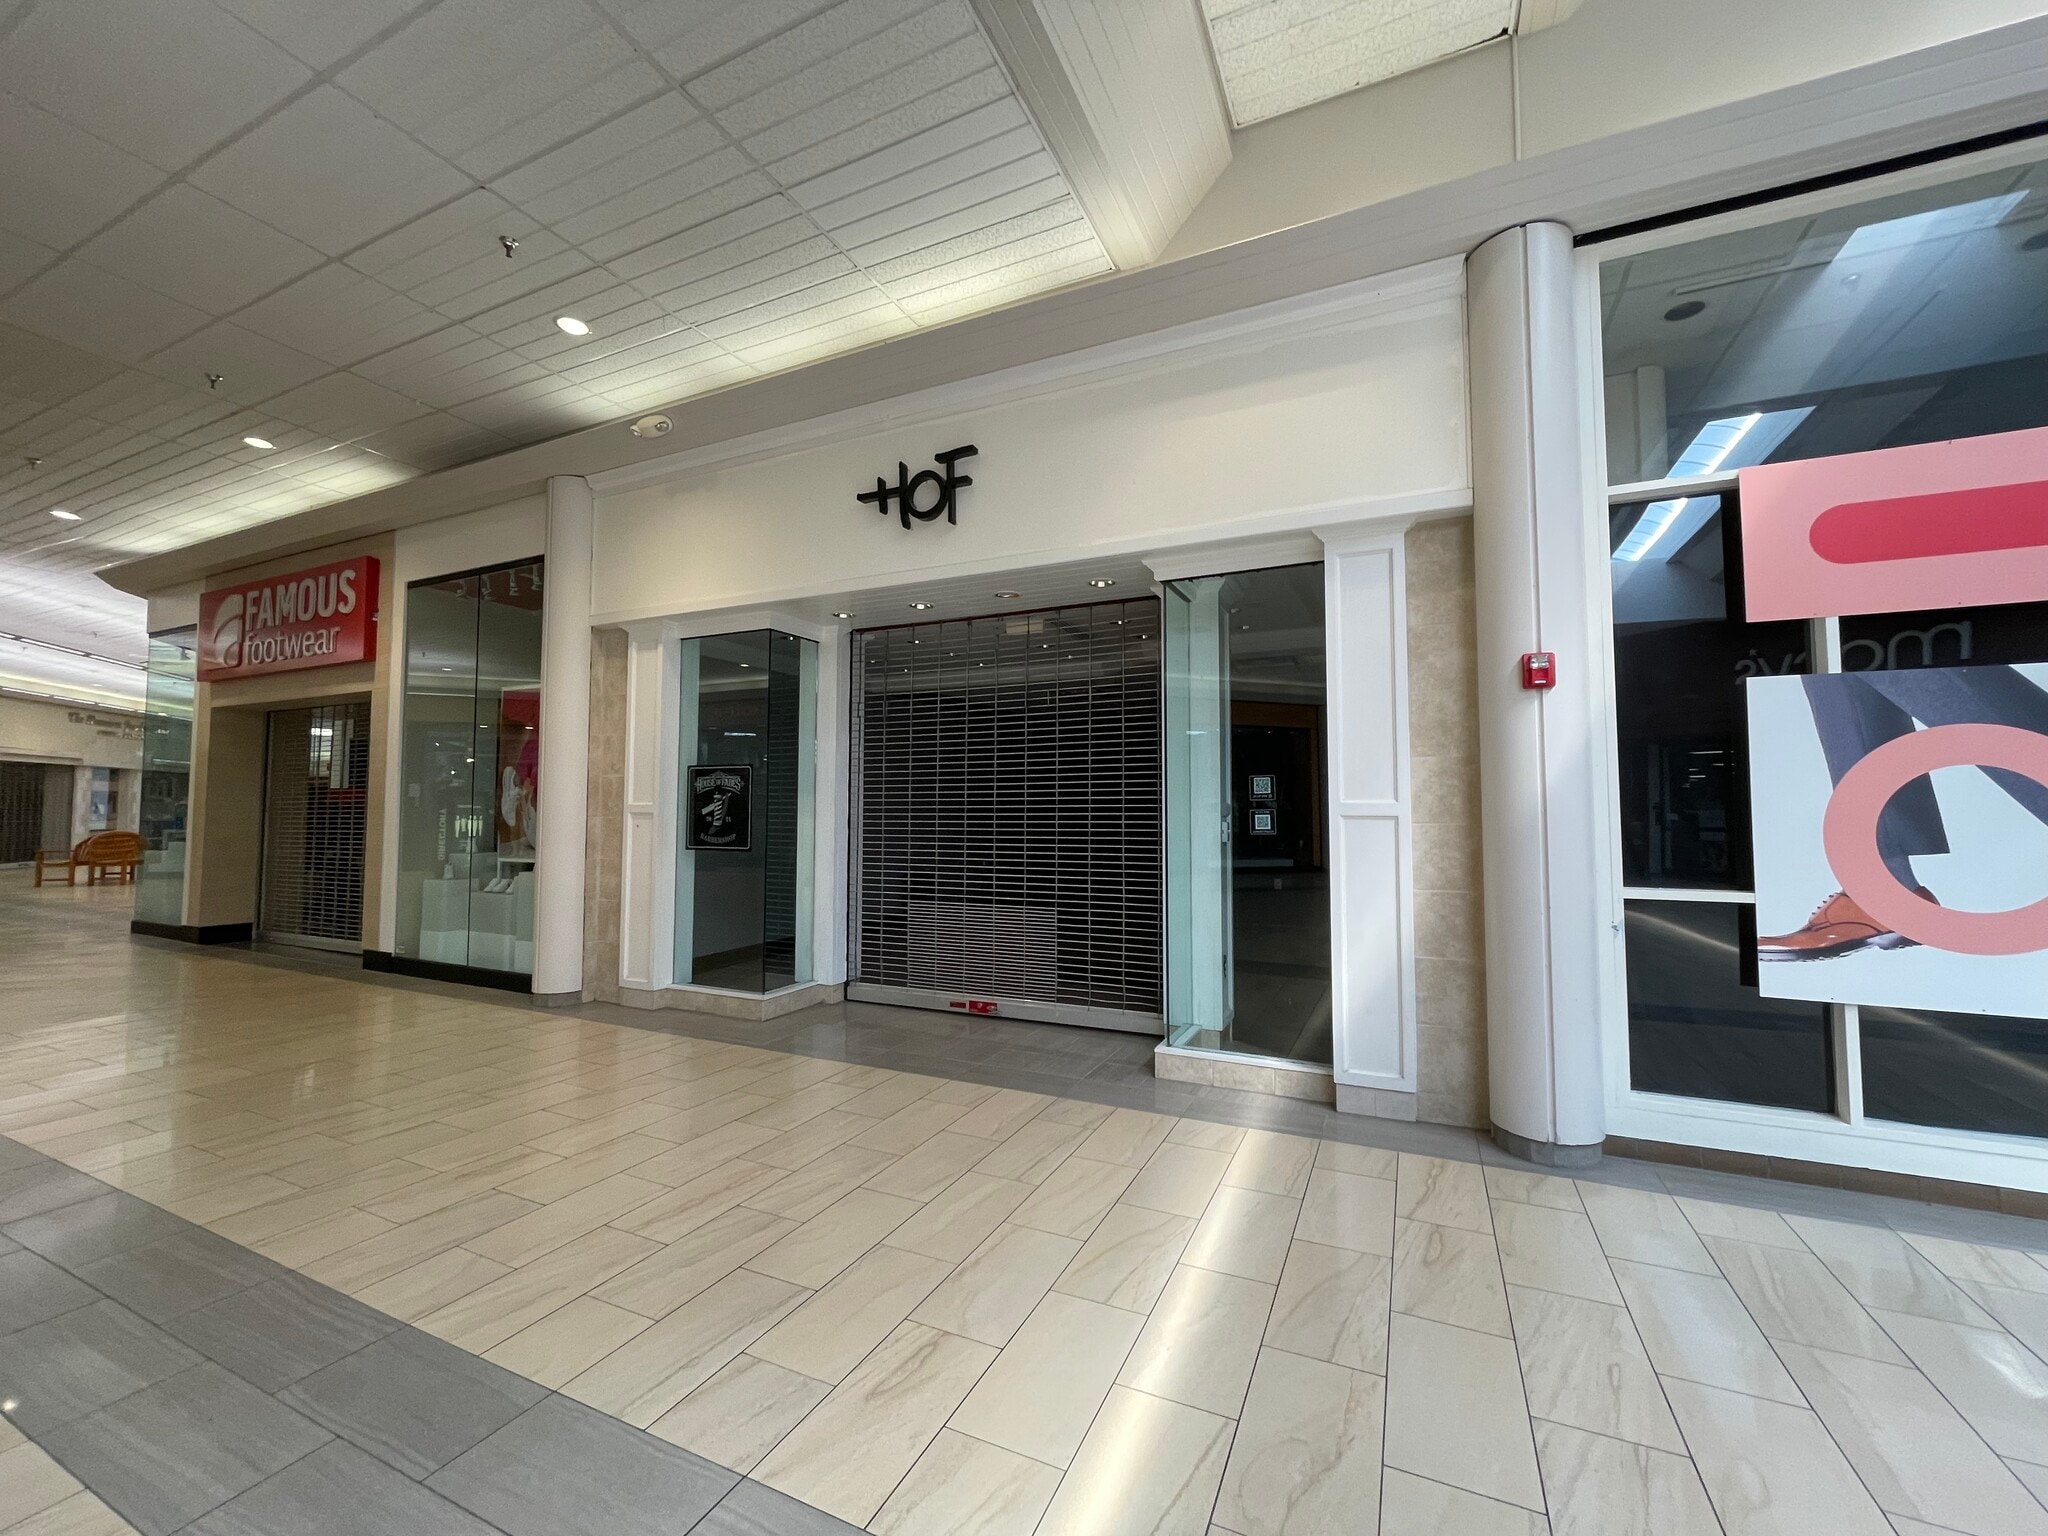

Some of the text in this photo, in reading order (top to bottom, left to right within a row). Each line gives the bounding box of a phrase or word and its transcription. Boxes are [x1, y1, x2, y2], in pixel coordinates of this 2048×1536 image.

[857, 444, 979, 530] HOF
[246, 569, 357, 632] FAMOUS
[244, 626, 341, 666] footwear
